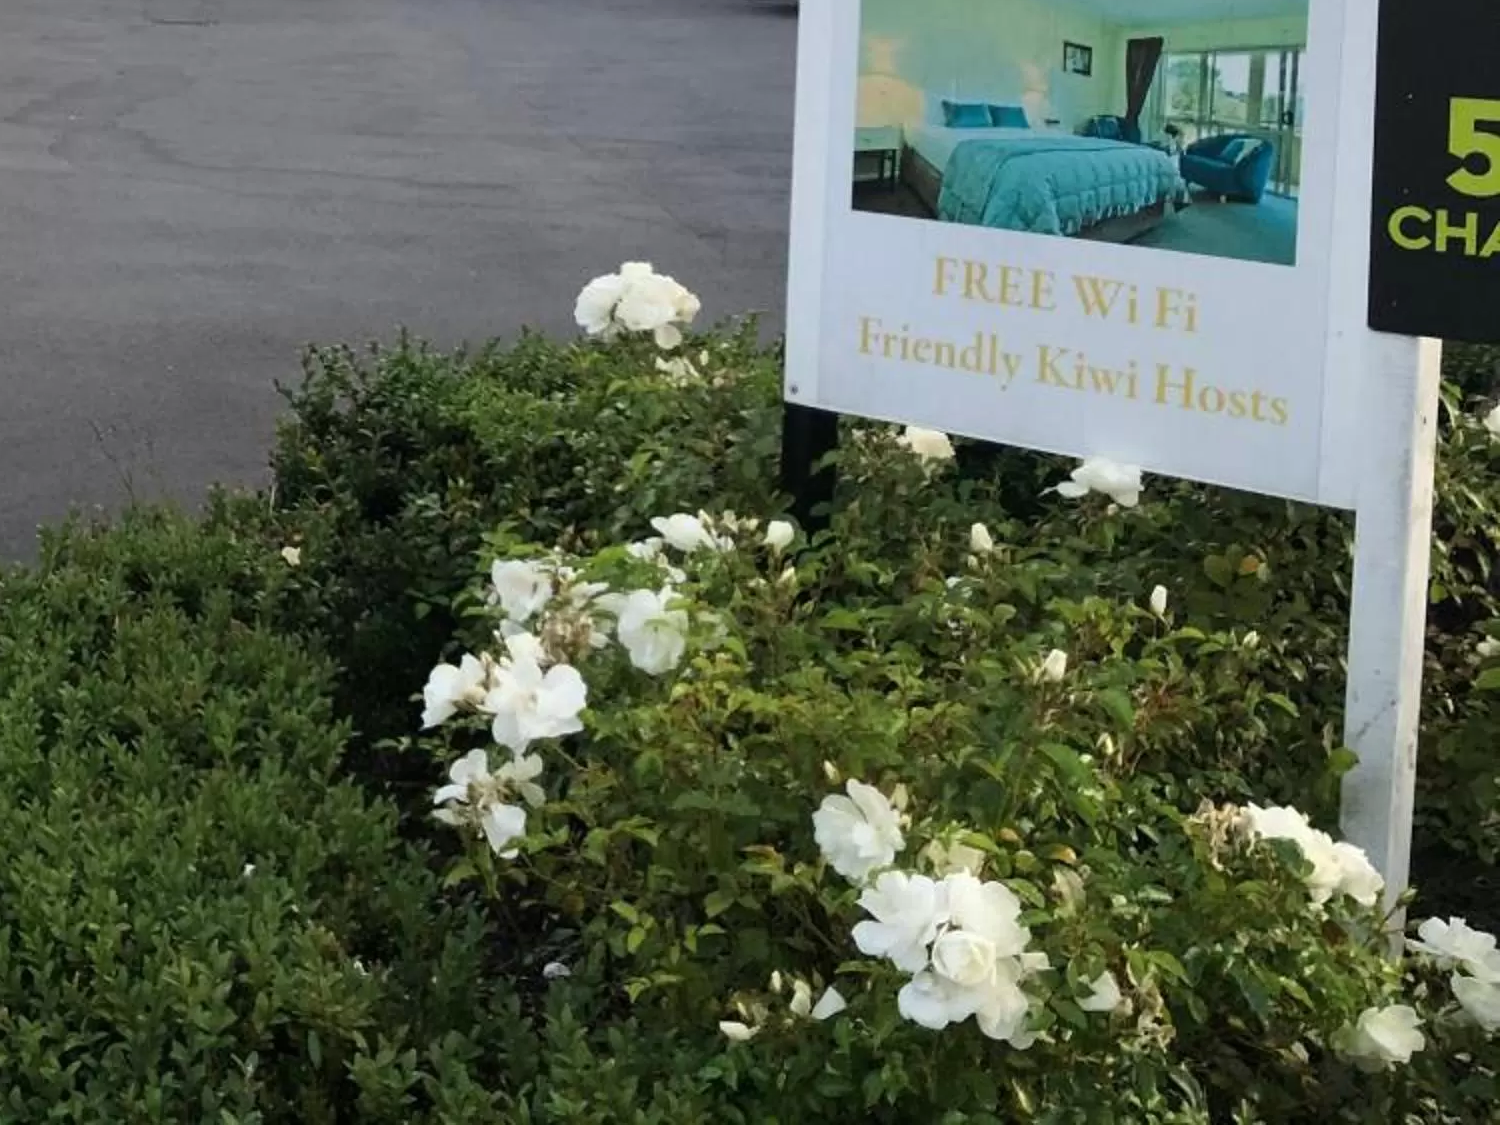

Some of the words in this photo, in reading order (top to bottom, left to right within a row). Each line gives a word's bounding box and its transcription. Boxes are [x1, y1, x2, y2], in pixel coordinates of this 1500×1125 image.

[932, 256, 1057, 312] FREE
[1072, 275, 1138, 324] Wi
[1155, 286, 1197, 333] Fi
[857, 316, 1023, 392] Friendly
[1034, 344, 1138, 400] Kiwi
[1155, 362, 1290, 425] Hosts
